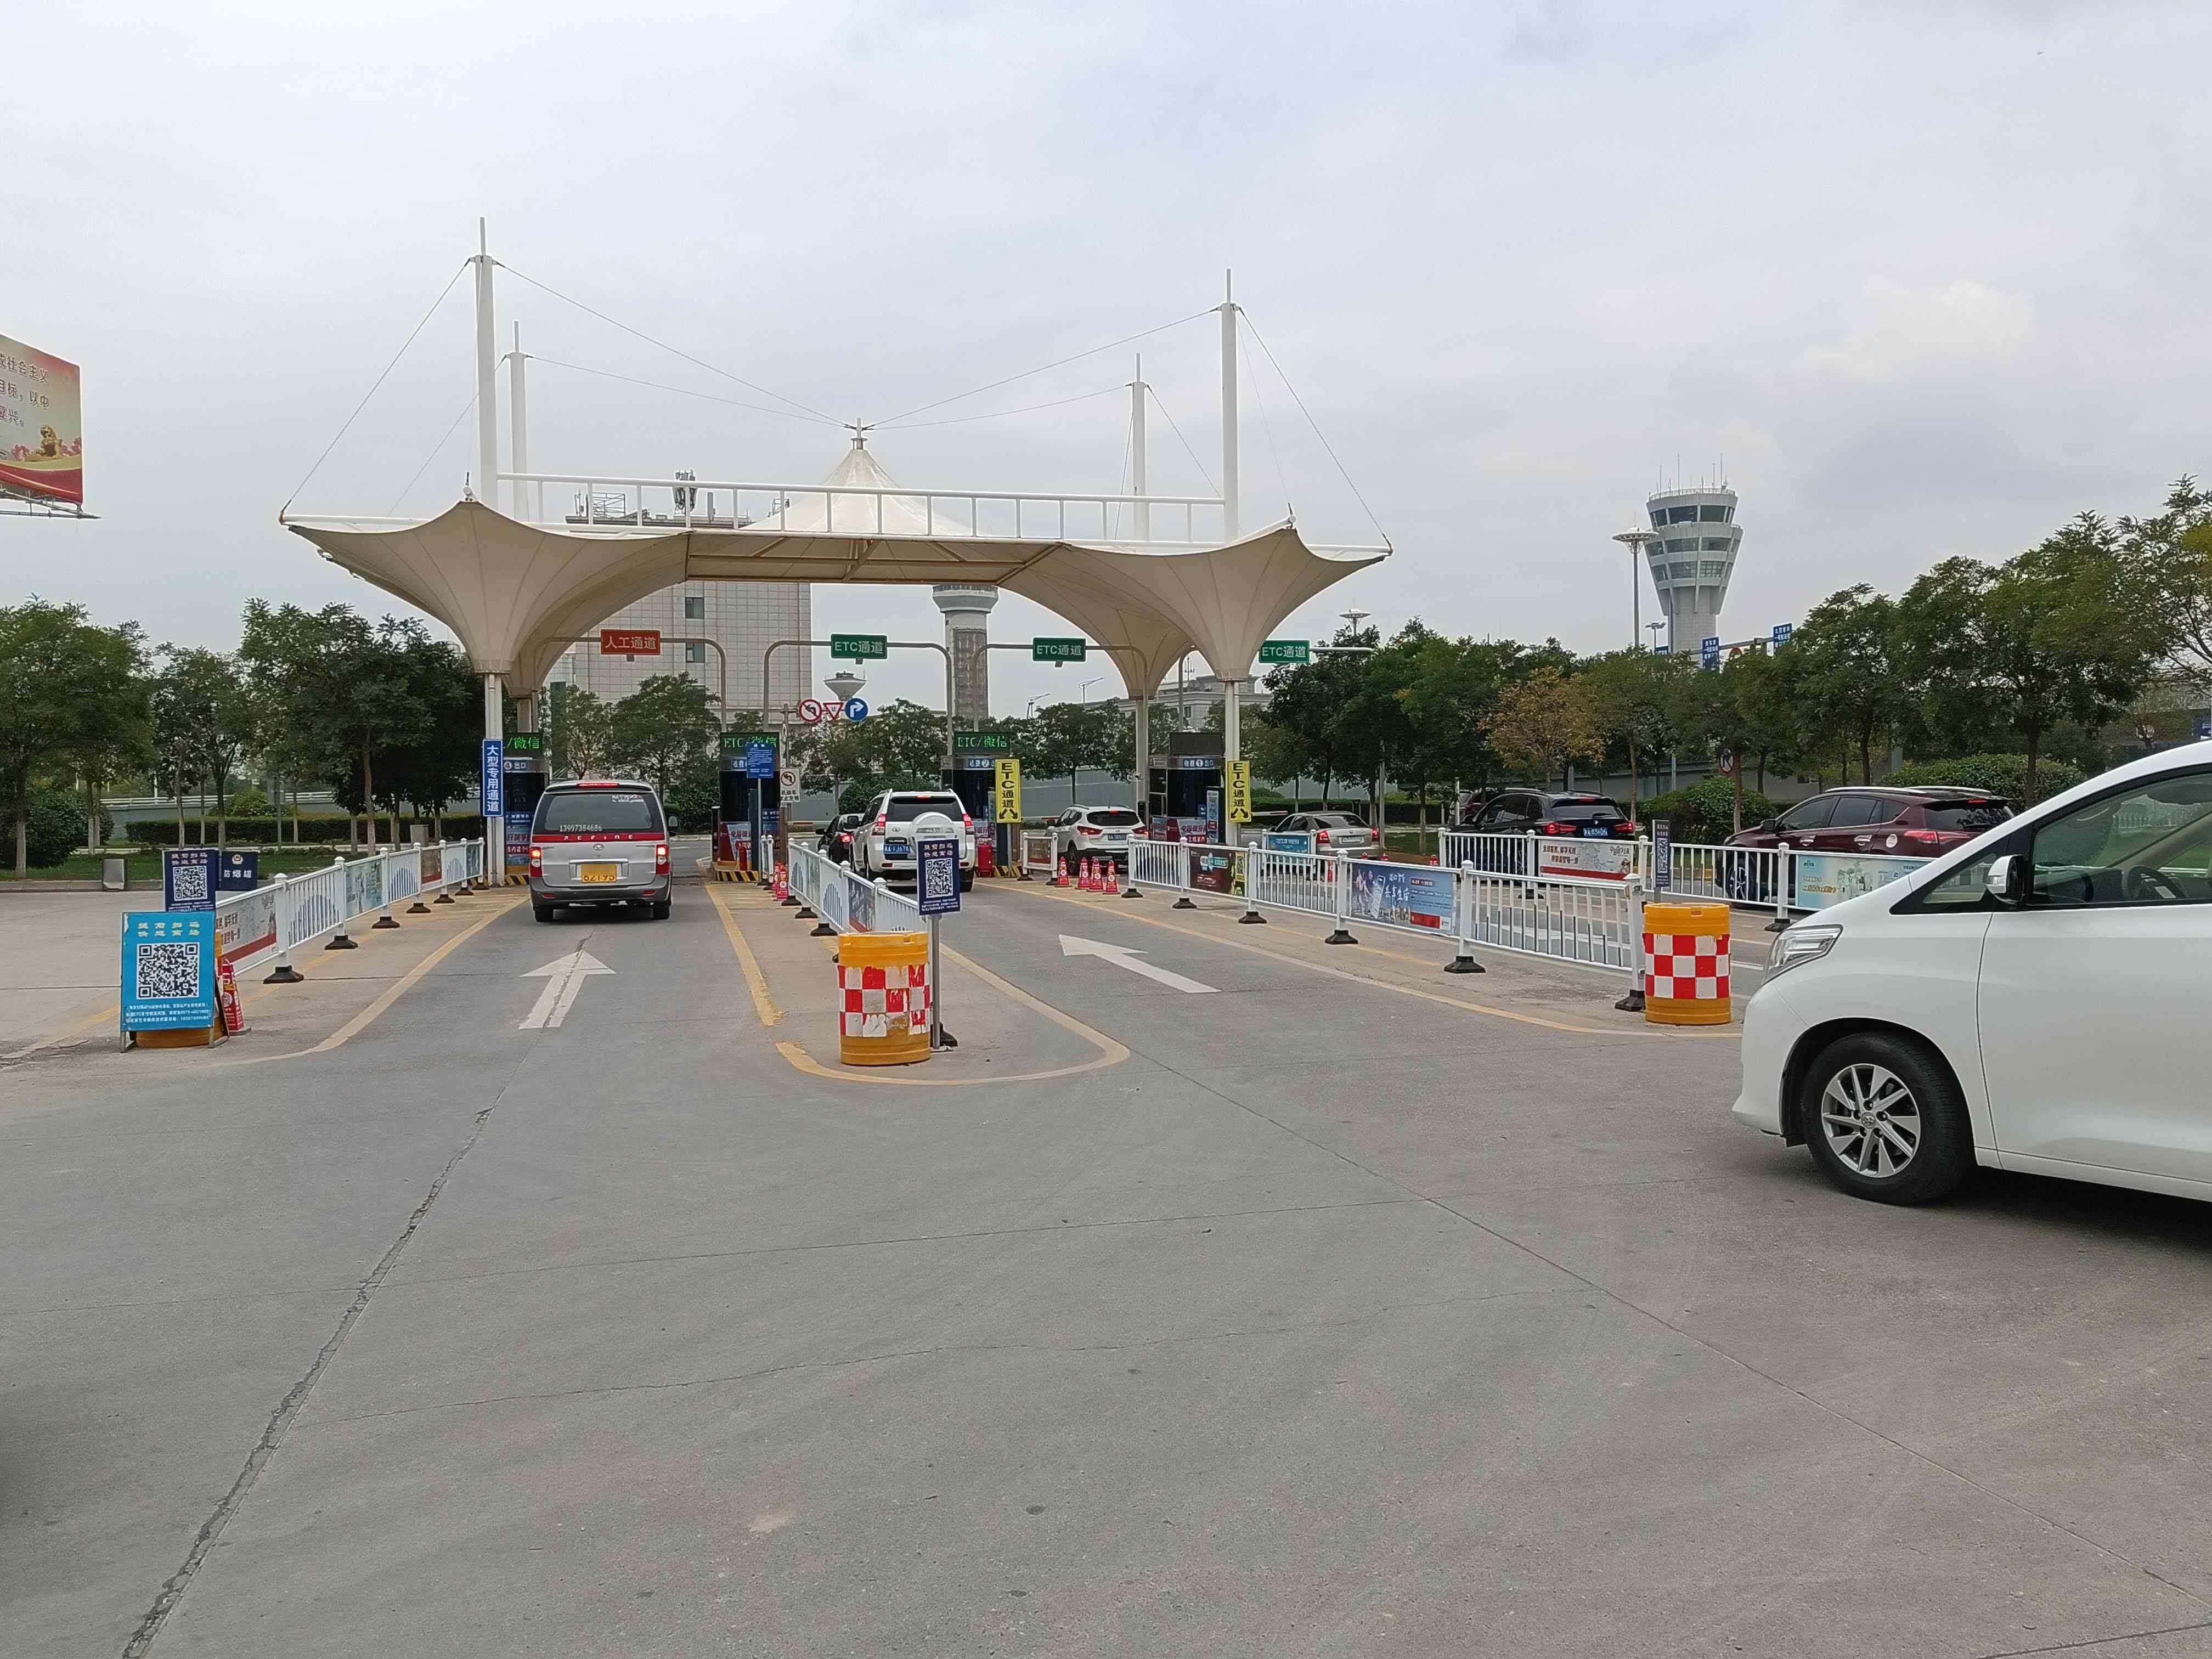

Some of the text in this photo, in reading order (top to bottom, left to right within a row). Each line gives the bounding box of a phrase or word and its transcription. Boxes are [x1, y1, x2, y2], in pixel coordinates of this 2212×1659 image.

[605, 635, 656, 650] 人工通道
[834, 641, 883, 654] ETC通道
[1037, 645, 1082, 656] ETC通道
[1262, 646, 1306, 658] ETC通道
[957, 735, 1007, 748] ETC/微信
[487, 745, 499, 812] 大型专用通道
[1002, 763, 1014, 808] ETC通道
[1233, 763, 1245, 807] ETC通道
